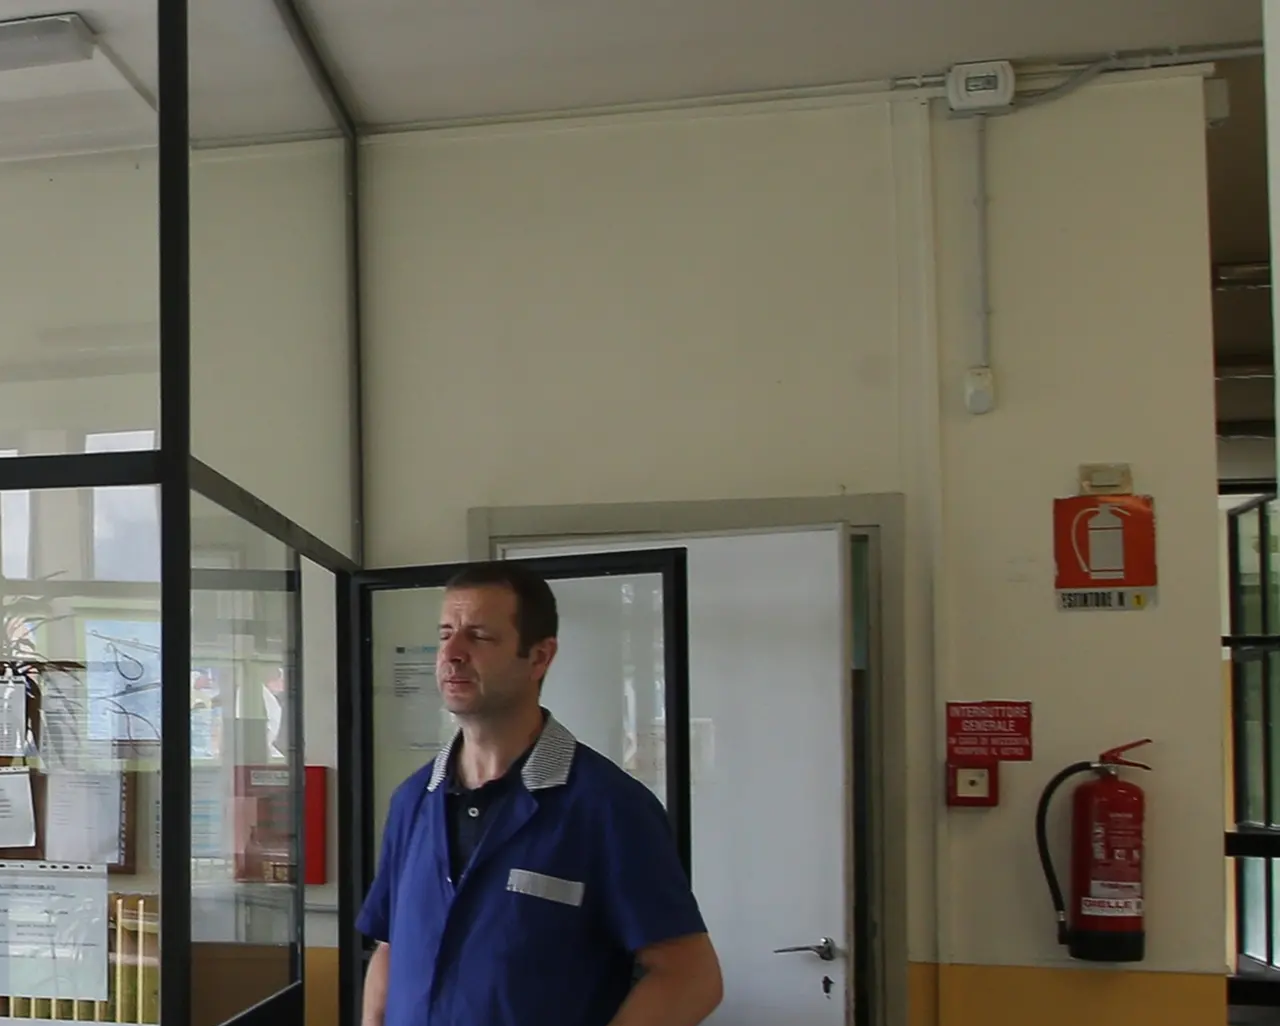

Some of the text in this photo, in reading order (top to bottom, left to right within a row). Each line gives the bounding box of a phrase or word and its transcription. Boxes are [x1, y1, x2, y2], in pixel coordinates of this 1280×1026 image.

[1061, 592, 1112, 608] ESTINTORE
[949, 706, 1028, 717] INTERRUTTORE
[961, 720, 1015, 731] GENERALE
